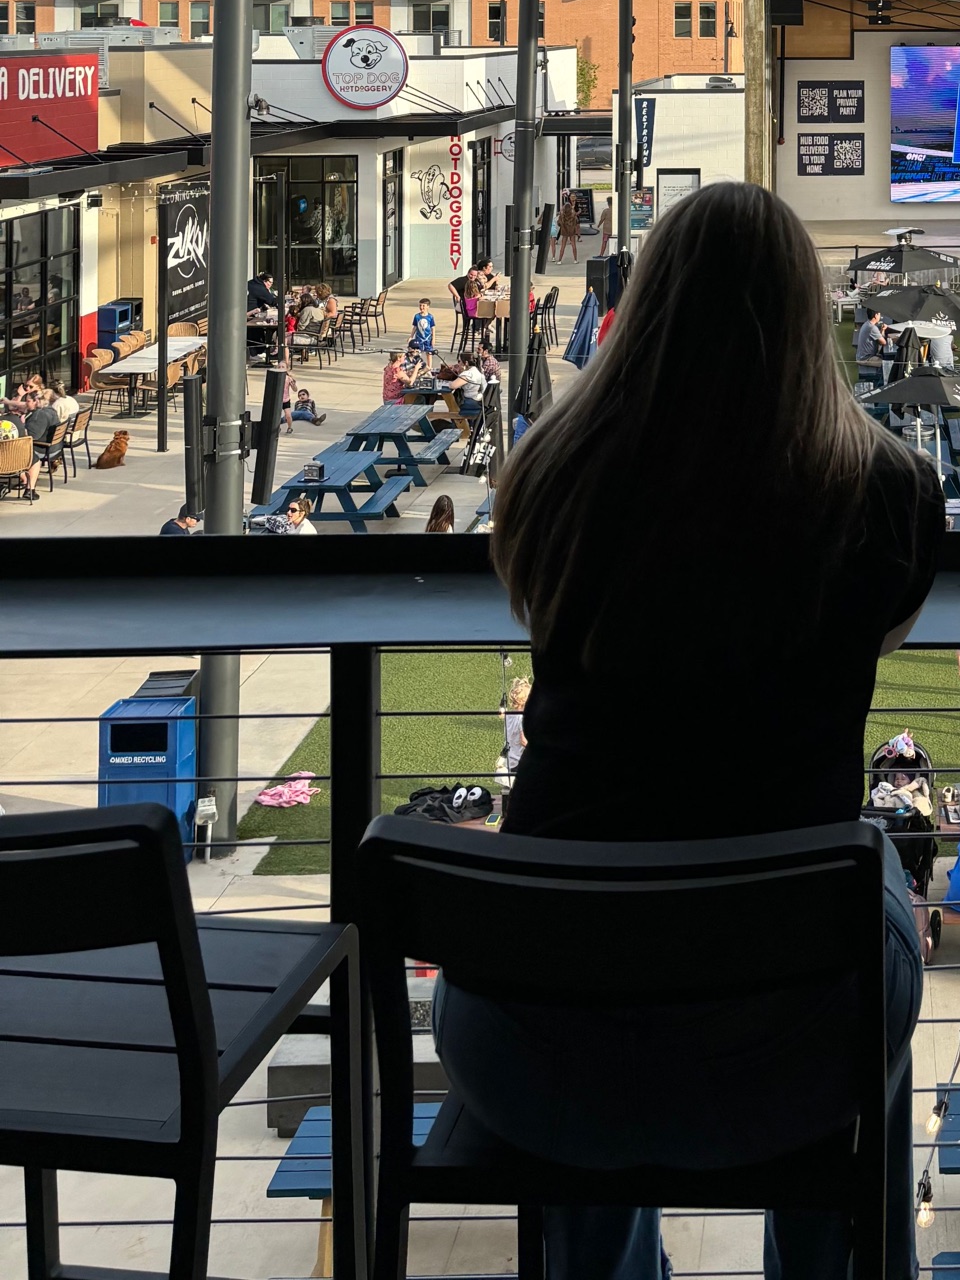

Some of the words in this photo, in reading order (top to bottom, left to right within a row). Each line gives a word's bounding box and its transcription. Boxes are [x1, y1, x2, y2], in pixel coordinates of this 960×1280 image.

[18, 65, 95, 100] DELIVERY
[332, 72, 364, 84] TOP
[366, 72, 400, 84] DOG
[833, 89, 847, 97] PLAN
[848, 89, 863, 97] YOUR
[836, 98, 858, 107] PRIVATE
[839, 107, 857, 115] PARTY
[800, 136, 812, 145] HUB
[814, 136, 829, 145] FOOD
[800, 146, 829, 154] DELIVERED
[802, 155, 810, 164] TO
[810, 155, 825, 164] YOUR
[905, 153, 926, 162] OMG!
[806, 165, 822, 174] HOME
[932, 318, 957, 327] RANCH
